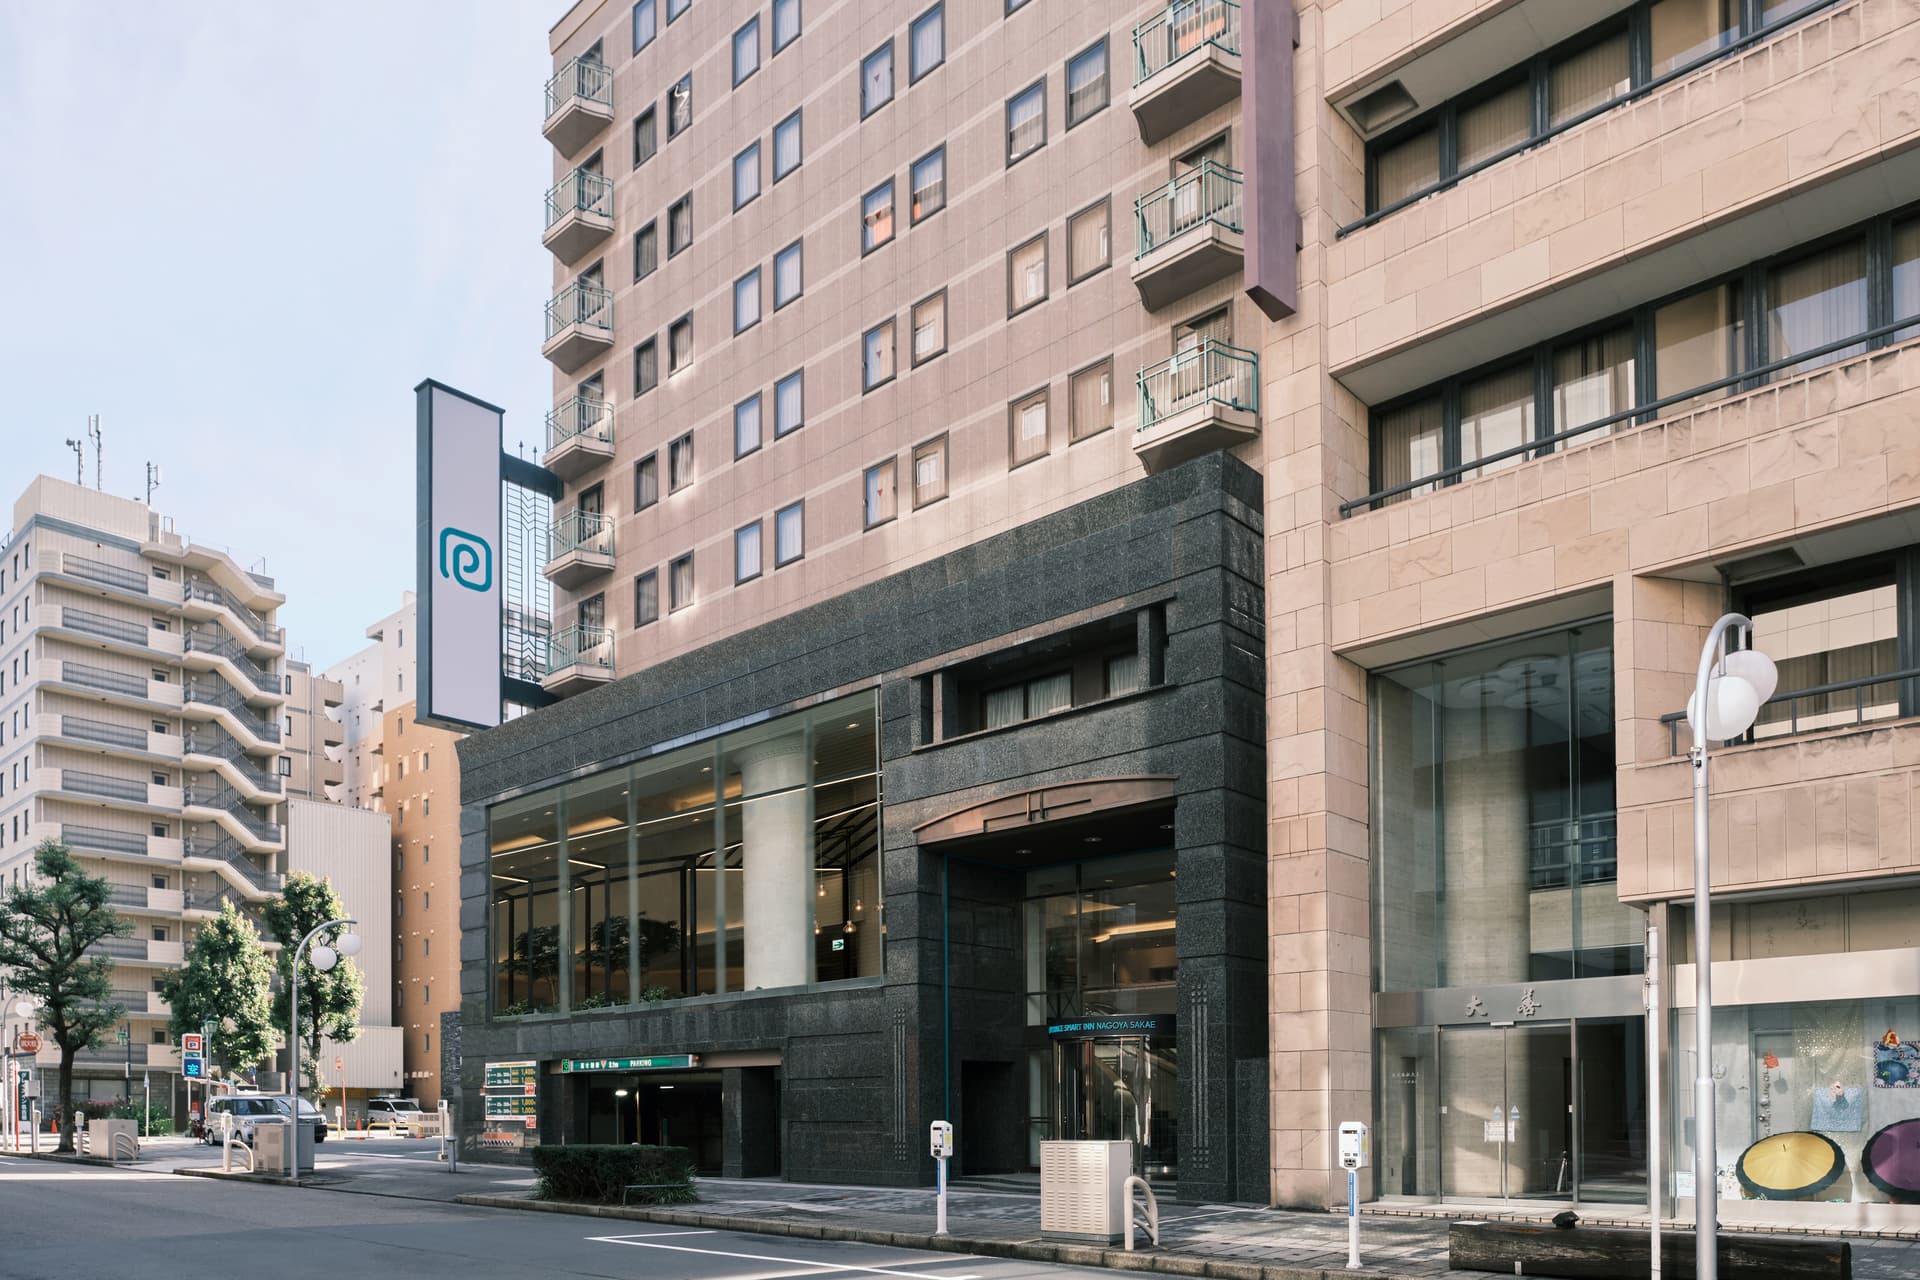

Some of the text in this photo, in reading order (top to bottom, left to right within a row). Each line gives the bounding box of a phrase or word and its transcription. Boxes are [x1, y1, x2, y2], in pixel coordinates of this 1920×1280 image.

[1083, 1022, 1095, 1031] INN
[1096, 1020, 1129, 1030] NAGOYA
[1130, 1020, 1156, 1029] SAKAE
[630, 1059, 651, 1067] PARKING
